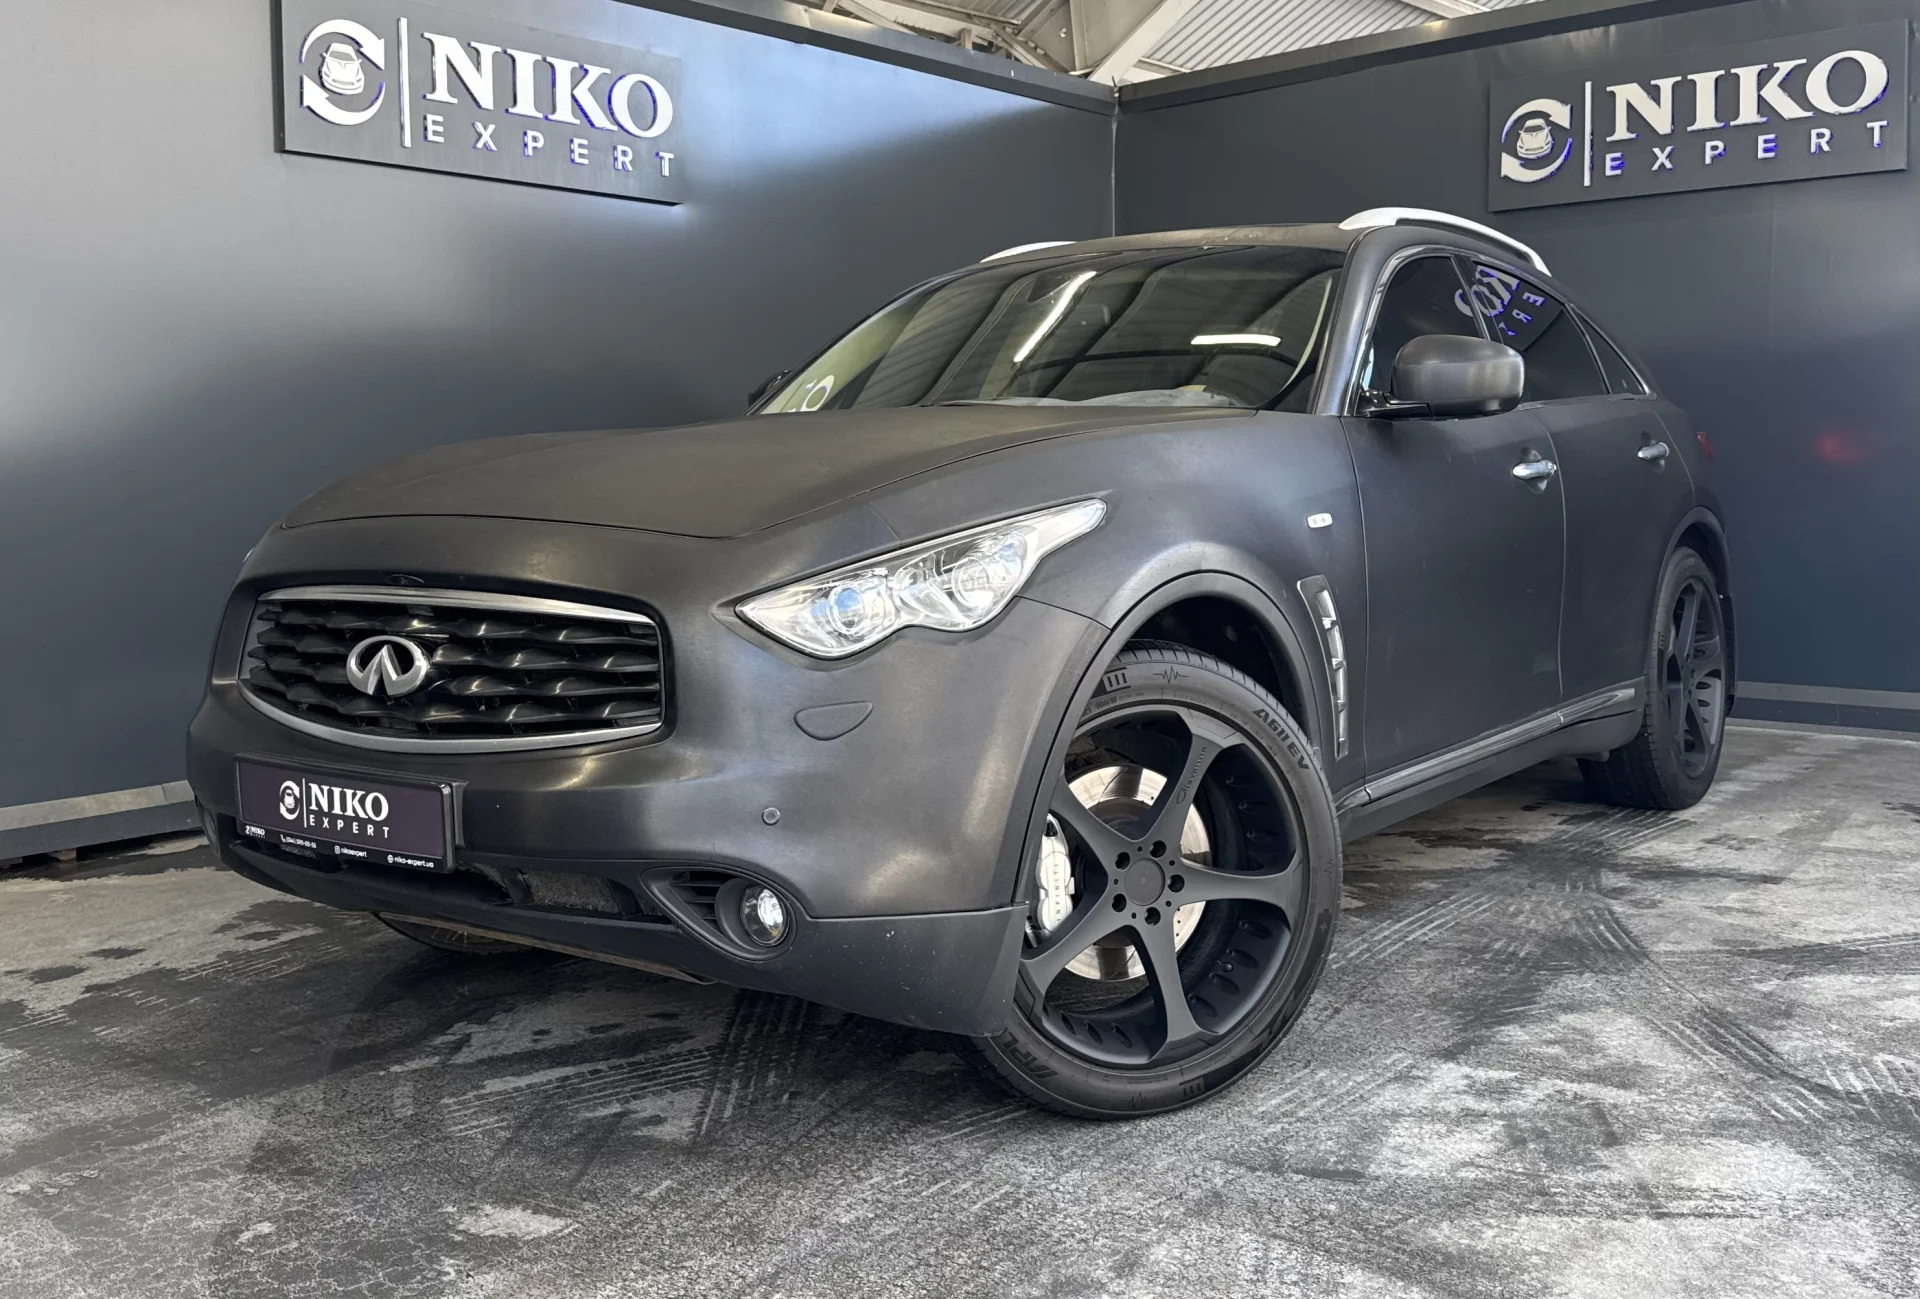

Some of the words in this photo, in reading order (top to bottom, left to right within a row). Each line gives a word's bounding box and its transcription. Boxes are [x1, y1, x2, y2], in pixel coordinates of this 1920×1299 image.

[421, 32, 674, 139] NIKO
[1605, 49, 1889, 142] NIKO
[423, 114, 674, 177] EXPERT
[1605, 120, 1889, 177] EXPERT
[1286, 741, 1310, 769] EV
[308, 782, 389, 821] NIKO
[309, 814, 390, 838] EXPERT
[394, 856, 435, 868] niko-expert.ua
